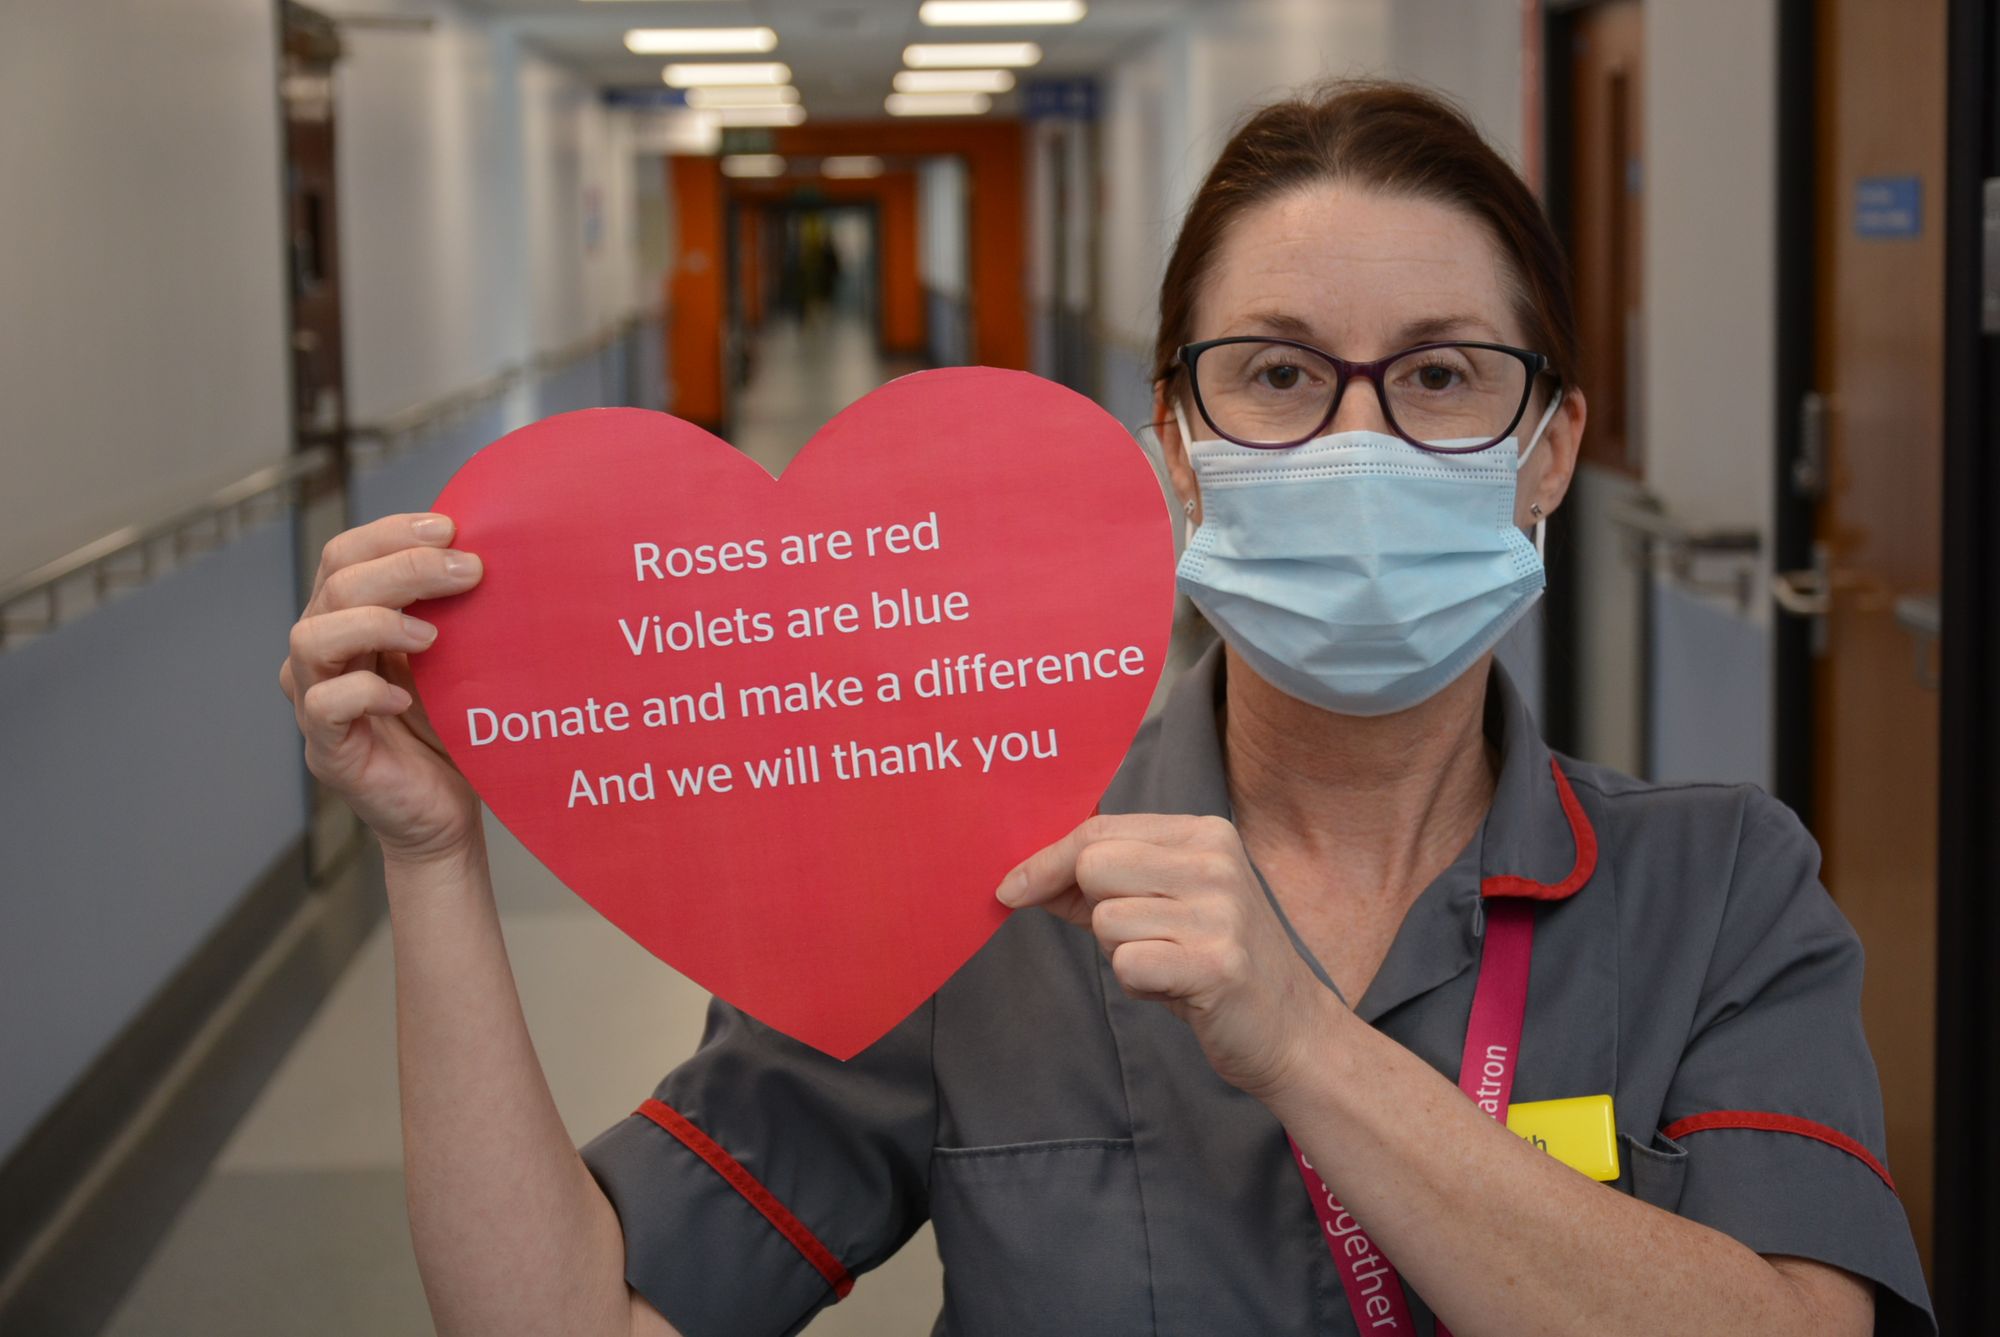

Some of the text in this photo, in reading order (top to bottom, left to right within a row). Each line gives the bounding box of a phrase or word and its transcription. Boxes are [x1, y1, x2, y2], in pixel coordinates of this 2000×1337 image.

[633, 511, 940, 582] Roses are red
[618, 588, 969, 656] Violets are blue
[466, 645, 1145, 746] Donate and make a difference
[568, 728, 1058, 808] And we will thank you
[1476, 1044, 1507, 1119] atron
[1321, 1182, 1398, 1329] ogether
